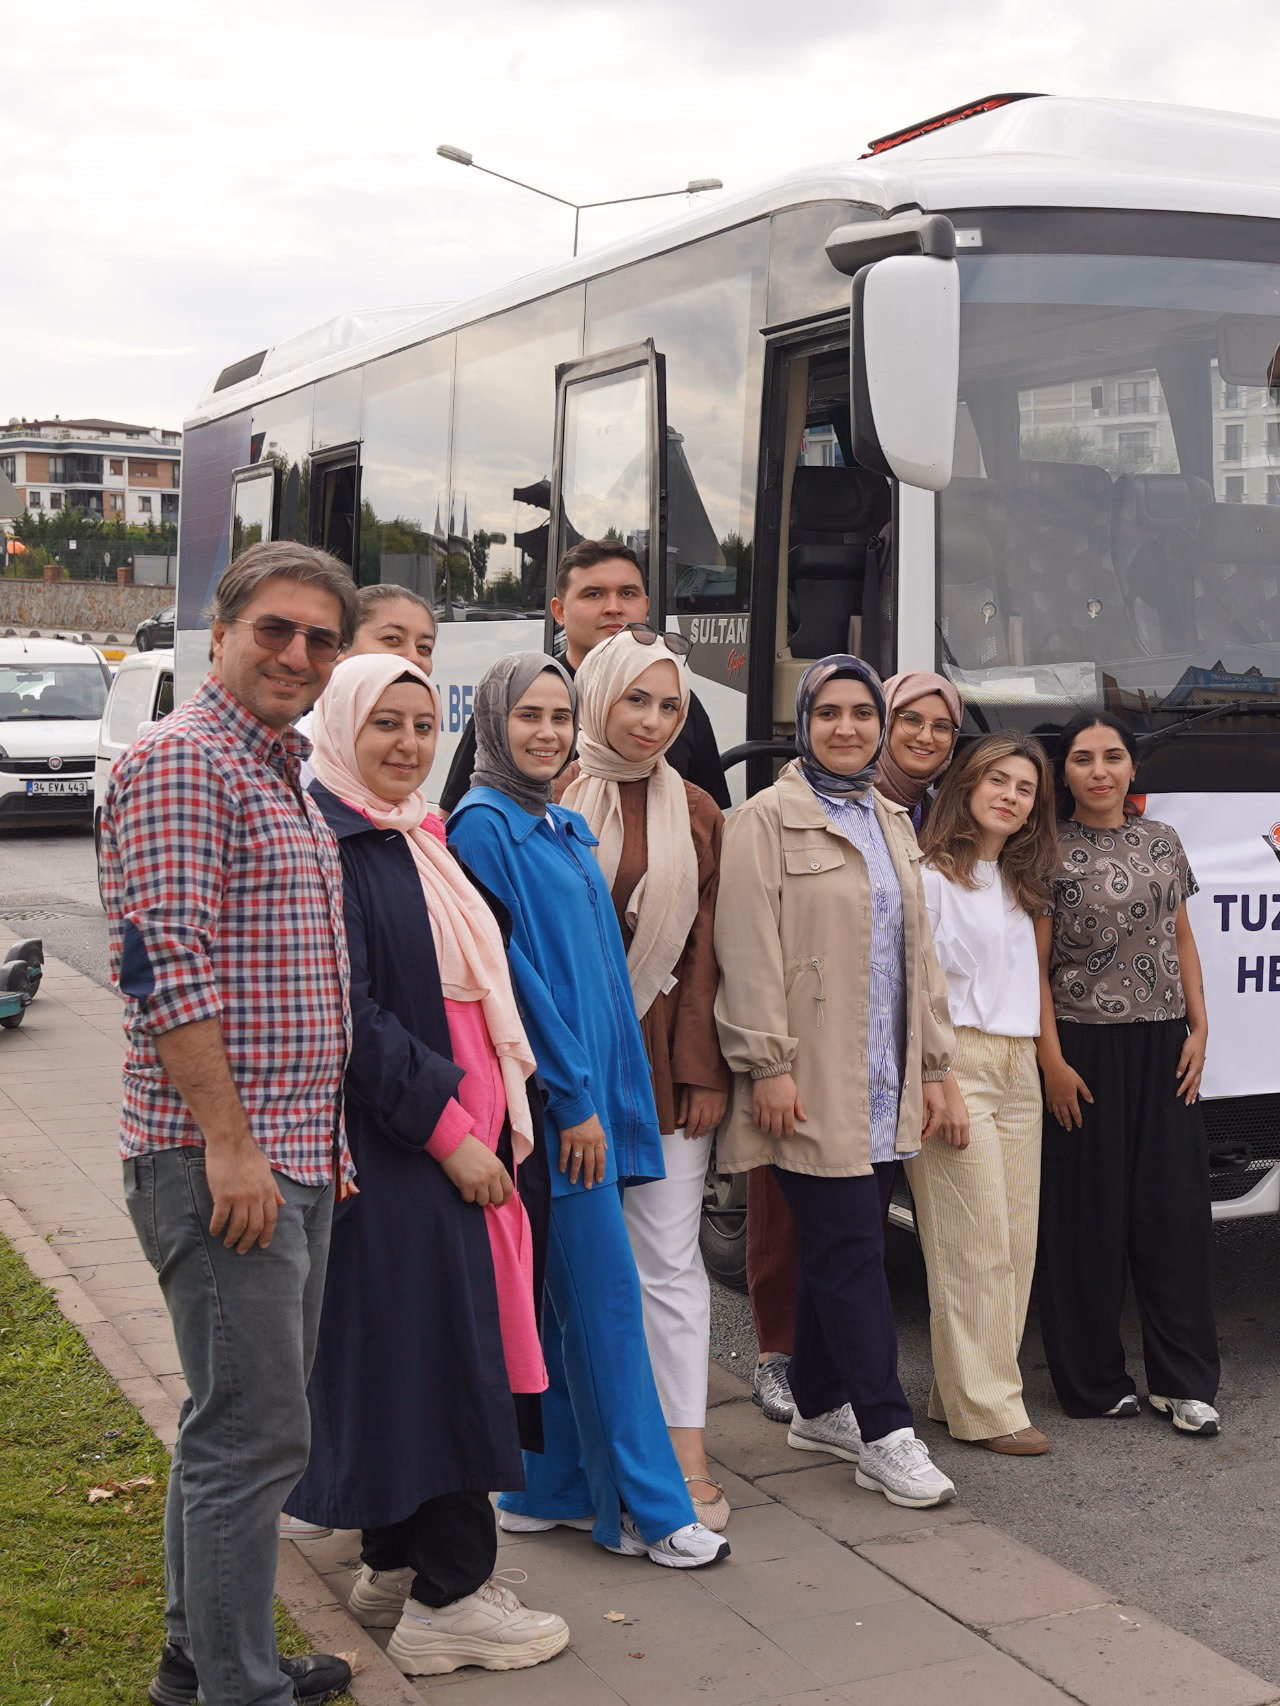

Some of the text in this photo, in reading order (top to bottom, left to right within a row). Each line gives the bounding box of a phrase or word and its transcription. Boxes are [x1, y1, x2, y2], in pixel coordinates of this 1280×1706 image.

[689, 618, 749, 644] SULTAN
[34, 783, 85, 792] 34 EVA 443
